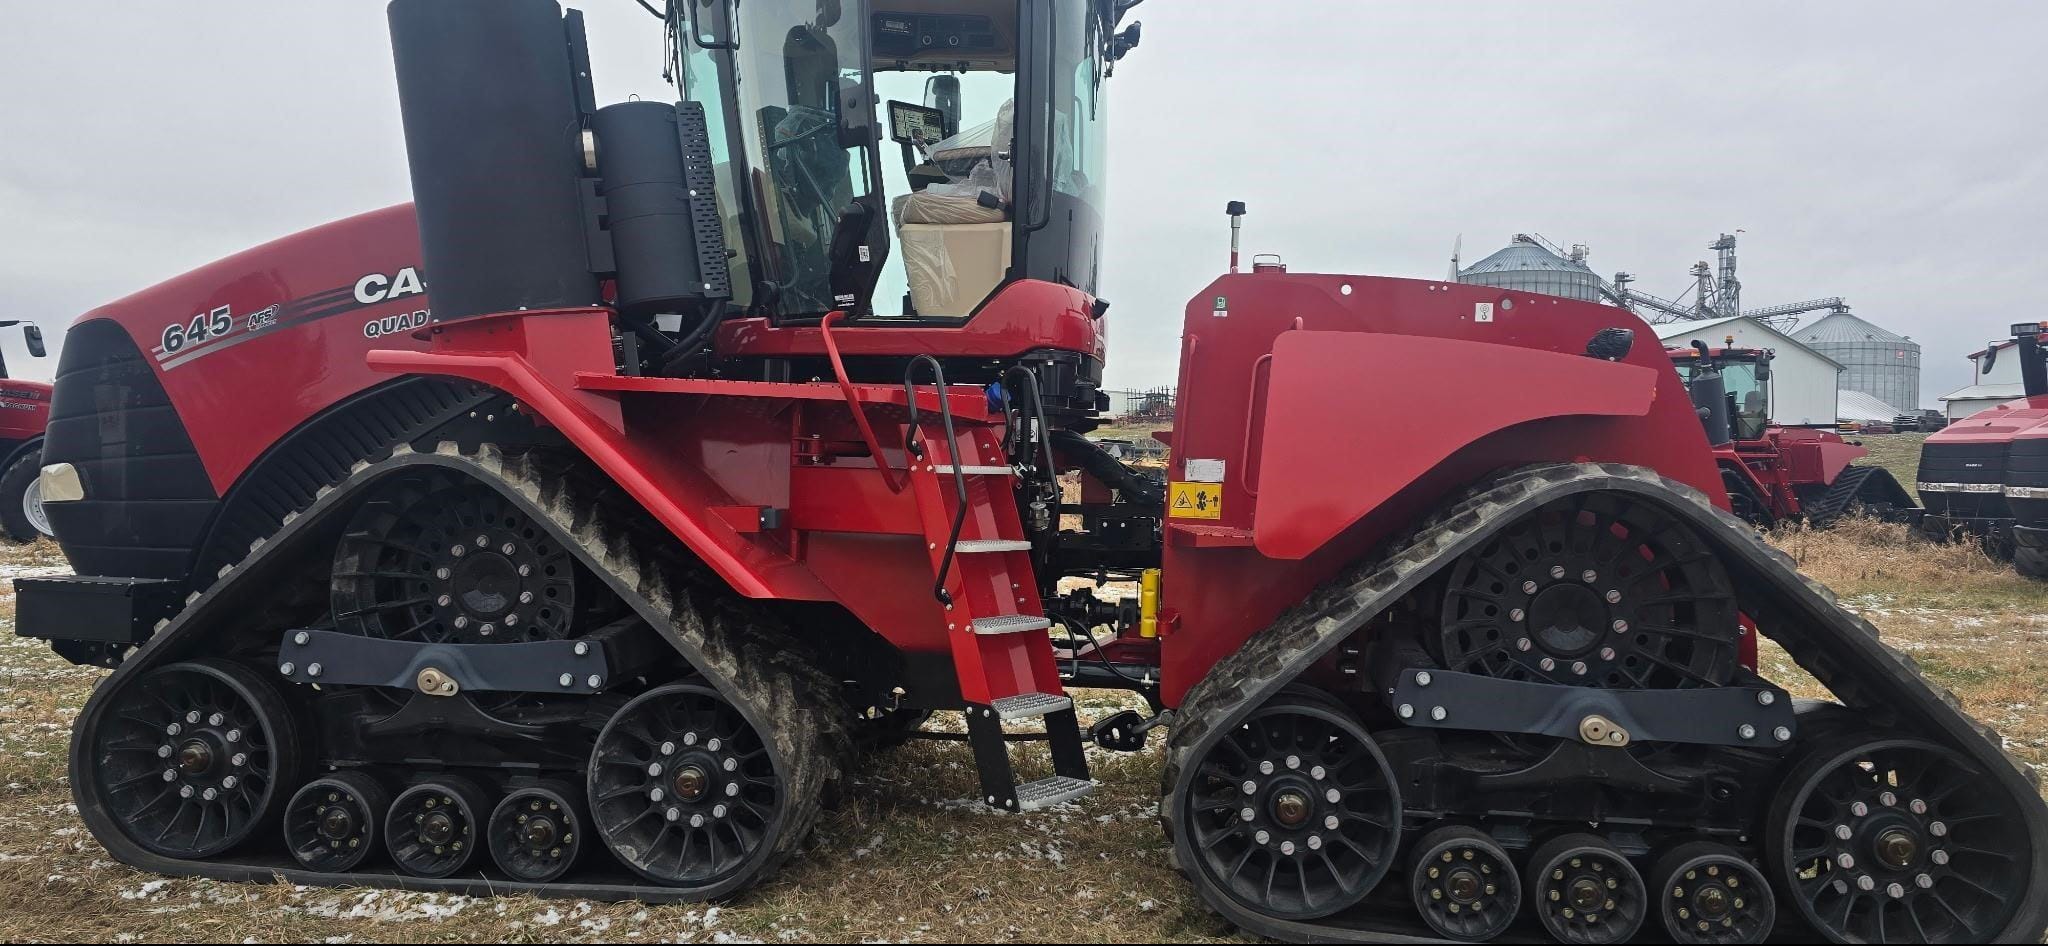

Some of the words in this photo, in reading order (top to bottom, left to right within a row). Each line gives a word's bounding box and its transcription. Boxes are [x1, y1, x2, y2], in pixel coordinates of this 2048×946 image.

[162, 303, 233, 354] 645
[247, 307, 273, 328] AFS
[363, 309, 431, 338] QUAD
